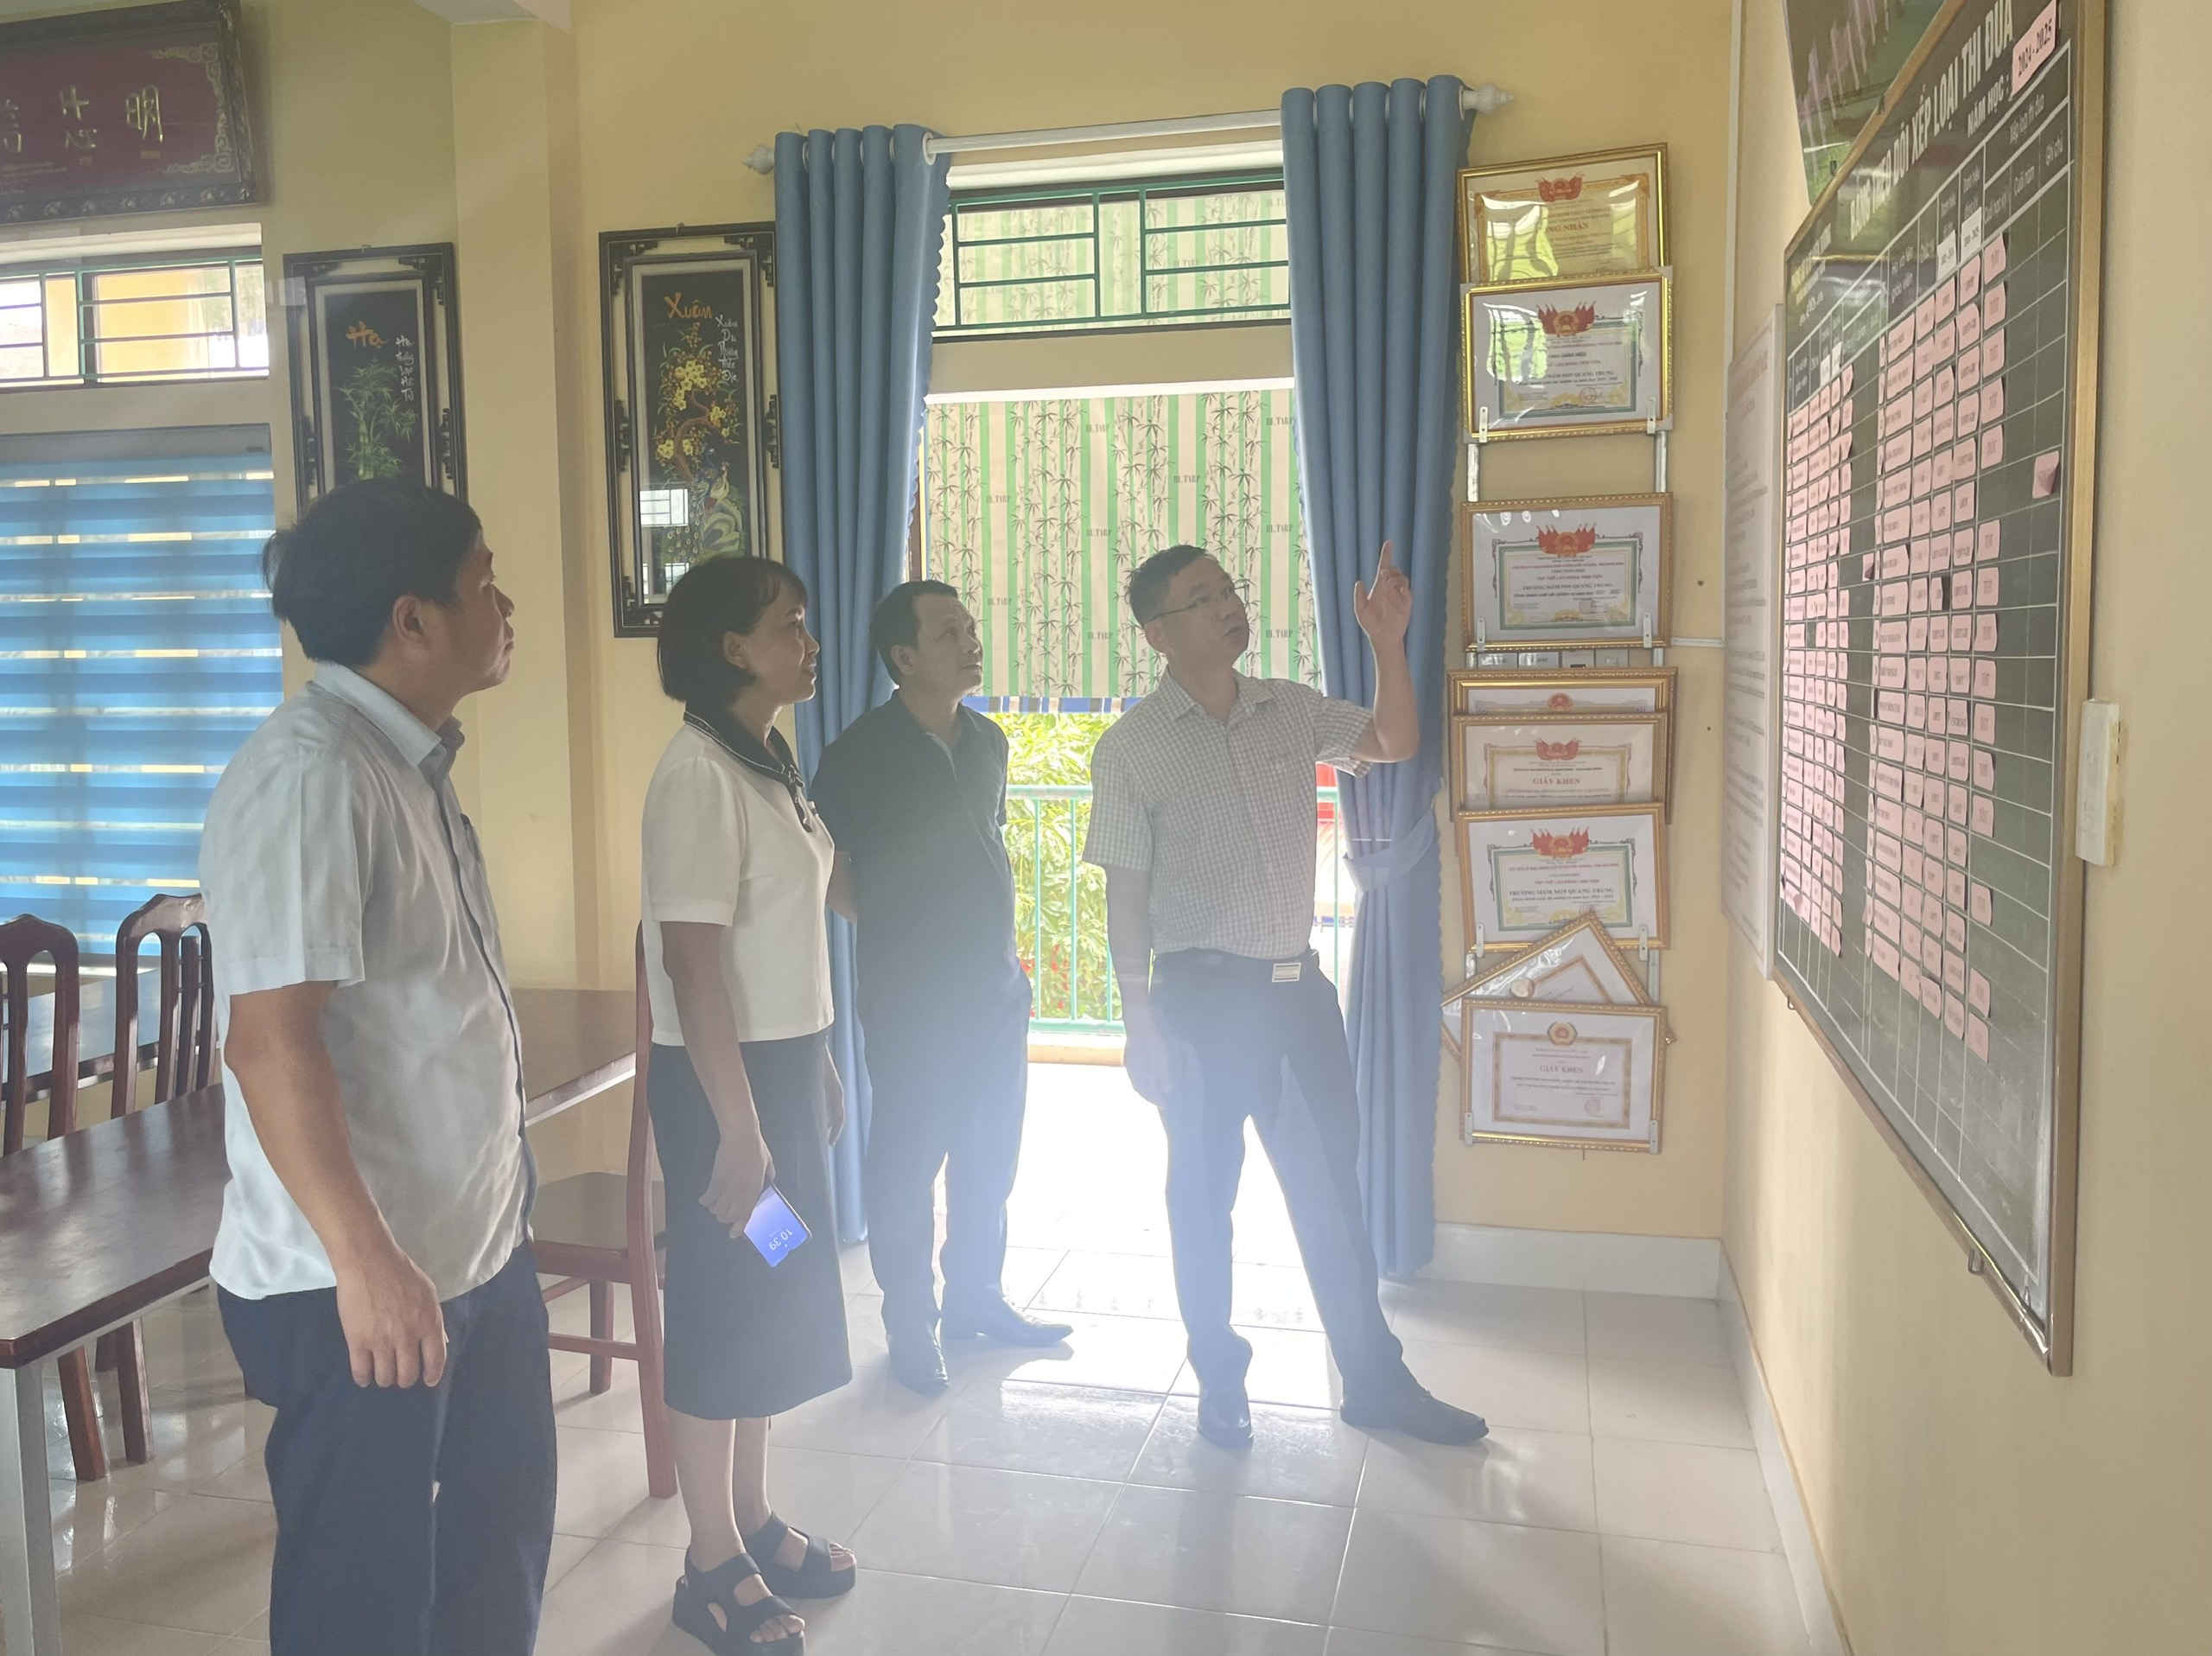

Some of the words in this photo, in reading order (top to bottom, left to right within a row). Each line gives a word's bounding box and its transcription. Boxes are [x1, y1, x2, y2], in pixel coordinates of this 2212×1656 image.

[1934, 55, 1959, 137] LOẠI
[1961, 24, 1981, 100] THI
[1985, 0, 2013, 72] ĐUA
[346, 320, 391, 349] Hạ
[1560, 1065, 1584, 1073] KHEN
